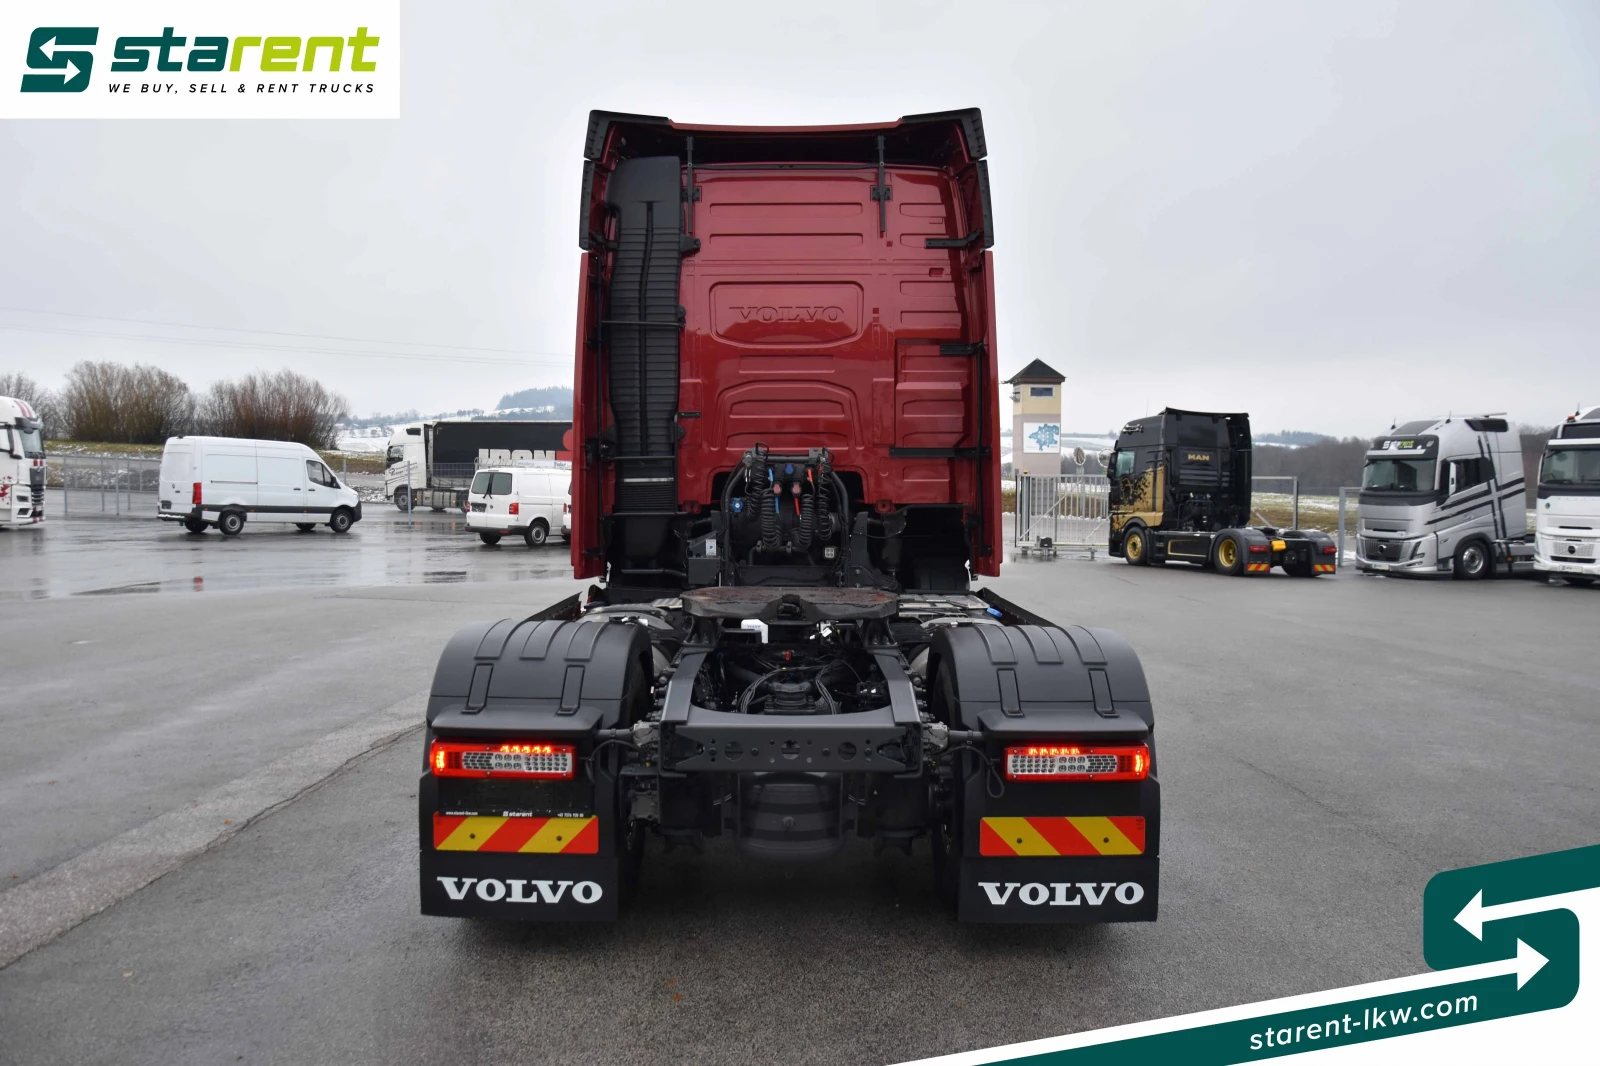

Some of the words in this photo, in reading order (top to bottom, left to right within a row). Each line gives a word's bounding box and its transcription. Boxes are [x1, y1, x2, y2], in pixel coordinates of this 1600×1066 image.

[729, 306, 844, 323] VOLVO
[1187, 453, 1210, 461] MAN
[437, 876, 603, 904] VOLVO
[978, 882, 1145, 906] VOLVO
